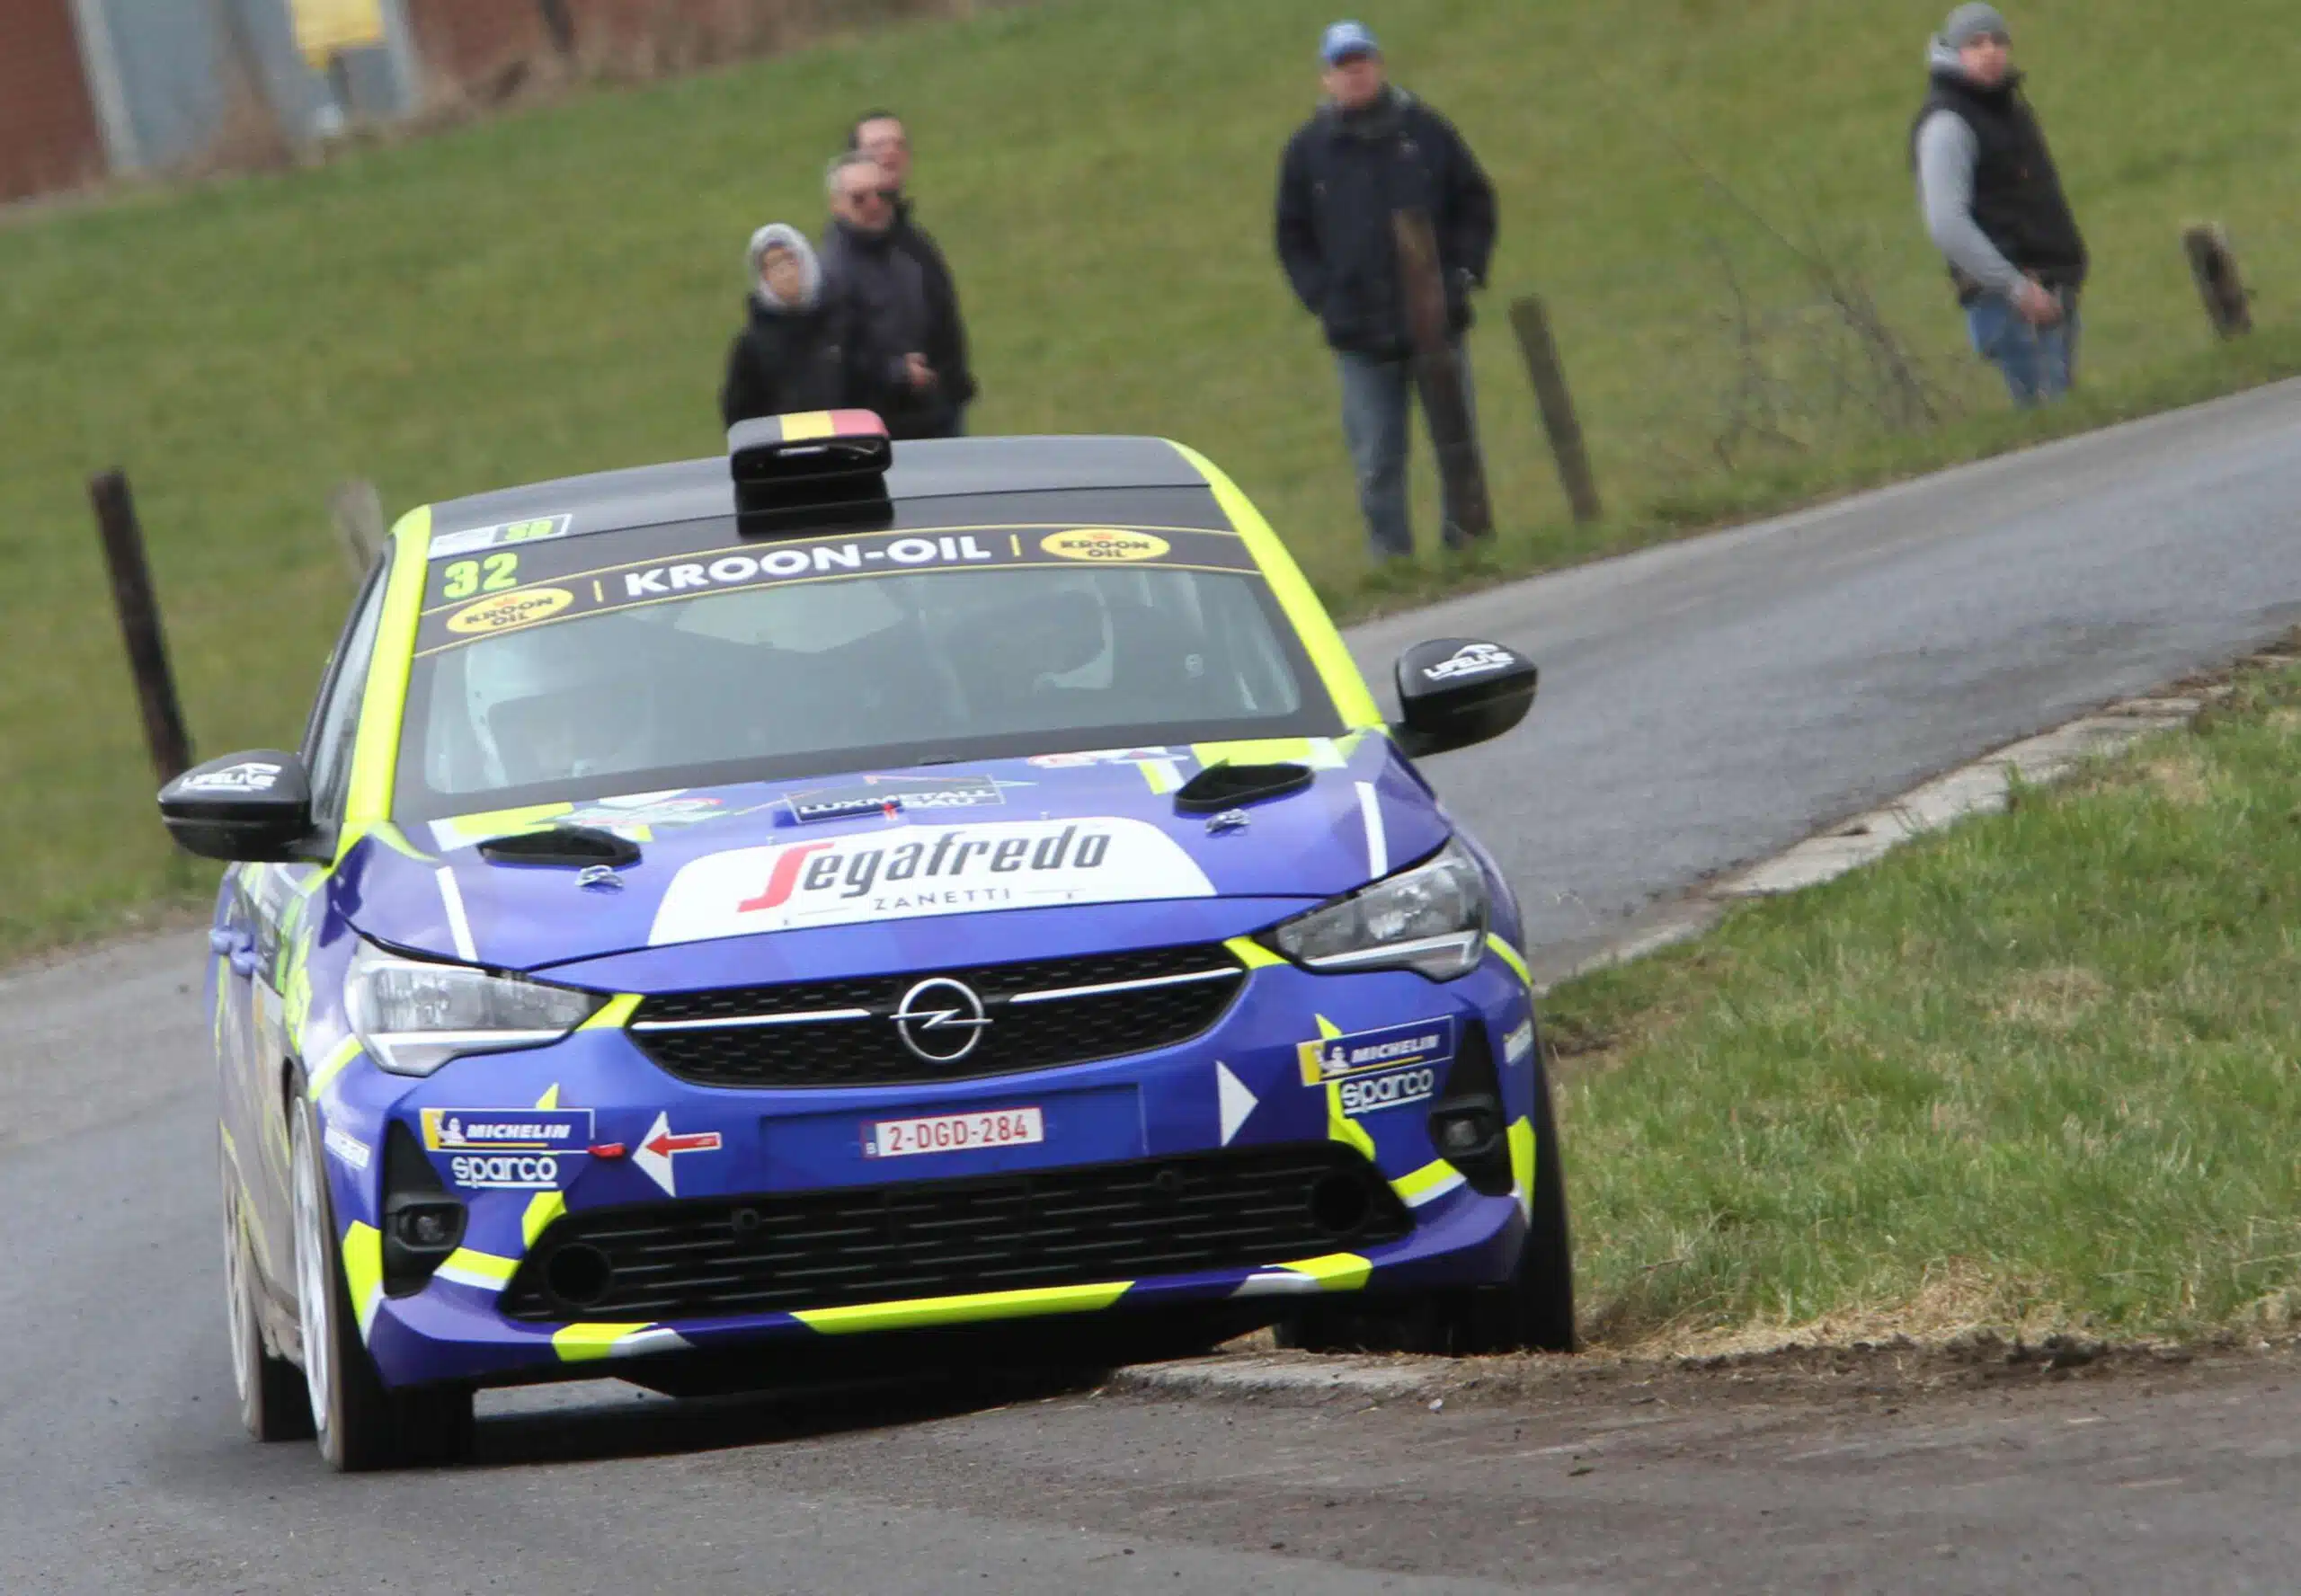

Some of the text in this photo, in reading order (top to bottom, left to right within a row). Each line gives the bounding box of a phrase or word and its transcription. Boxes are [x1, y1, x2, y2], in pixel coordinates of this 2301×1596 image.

[1060, 540, 1150, 550] KROON
[1088, 549, 1126, 558] OIL
[443, 553, 519, 599] 32
[624, 534, 991, 597] KROON-OIL
[465, 597, 555, 625] KROON
[492, 613, 531, 626] OIL
[736, 825, 1114, 913] Segafredo
[874, 888, 1012, 912] ZANETTI
[1351, 1034, 1441, 1064] MICHELIN
[1340, 1068, 1435, 1113] sparco
[466, 1123, 573, 1139] MICHELIN
[888, 1113, 1029, 1151] 2-DGD-284
[451, 1157, 558, 1189] sparco
